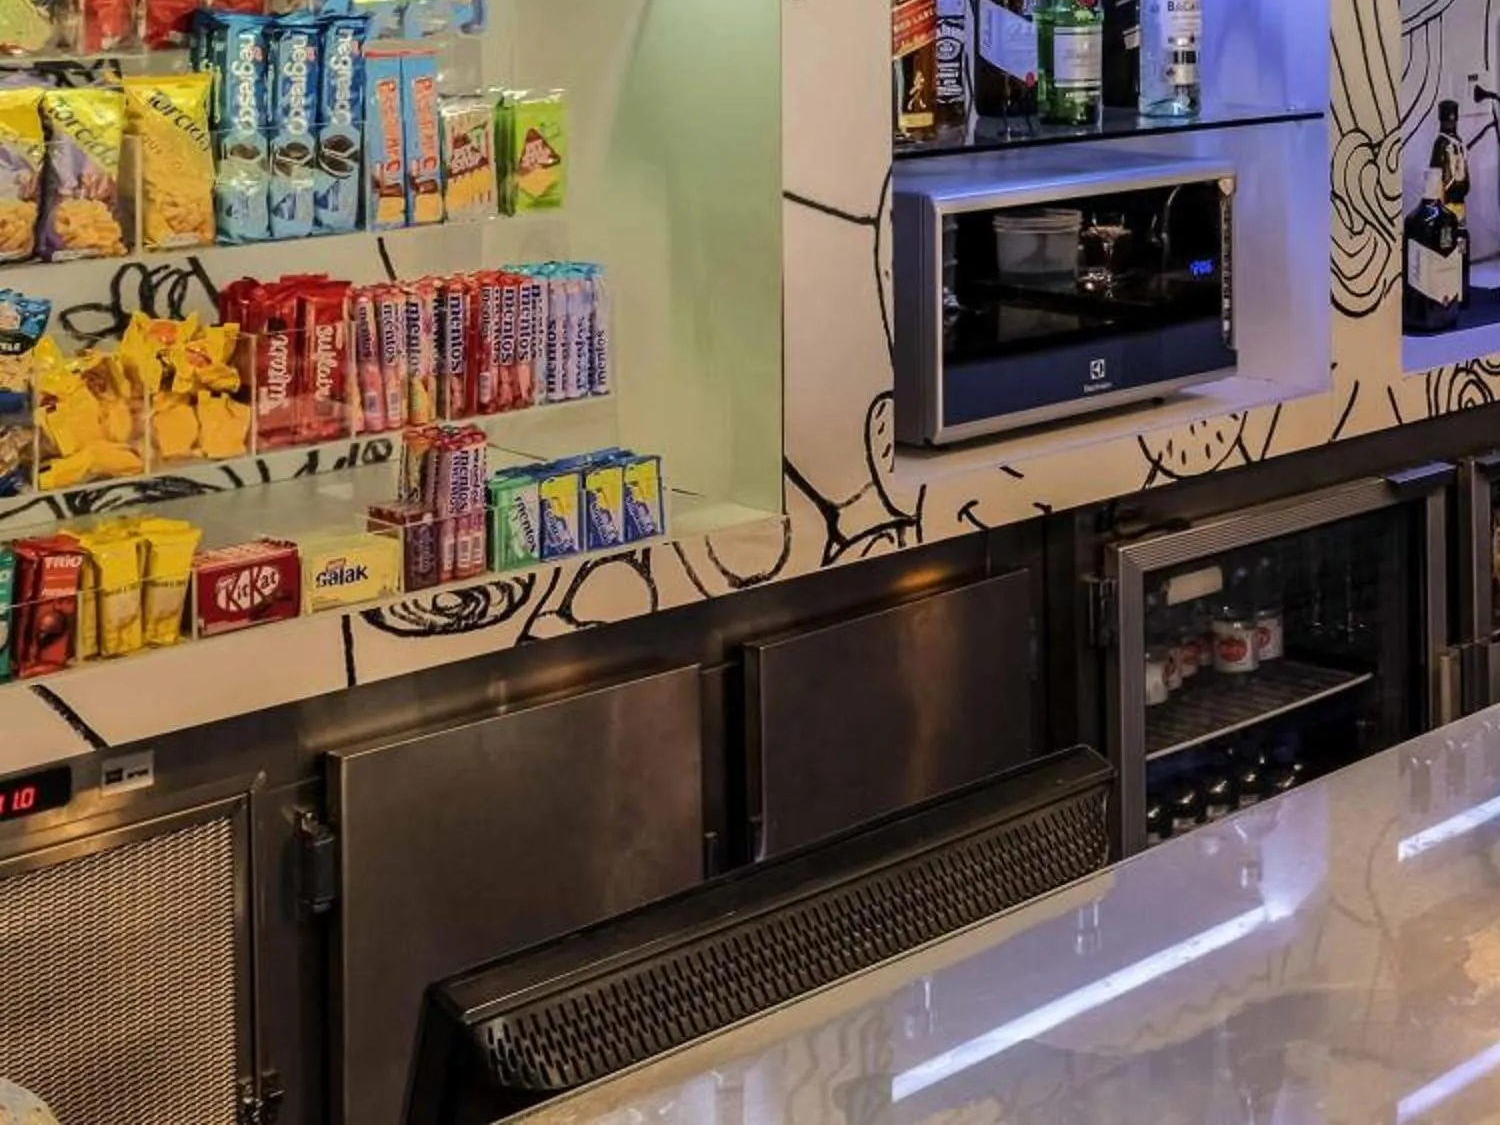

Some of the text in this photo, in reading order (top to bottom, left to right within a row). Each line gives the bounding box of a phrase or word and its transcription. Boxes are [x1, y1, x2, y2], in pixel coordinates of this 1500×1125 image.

[231, 34, 256, 135] negresco
[284, 35, 308, 135] negresco
[330, 28, 354, 126] negresco
[450, 295, 463, 372] mentos
[502, 288, 514, 364] mentos
[522, 285, 532, 362] mentos
[216, 565, 279, 612] KitKat
